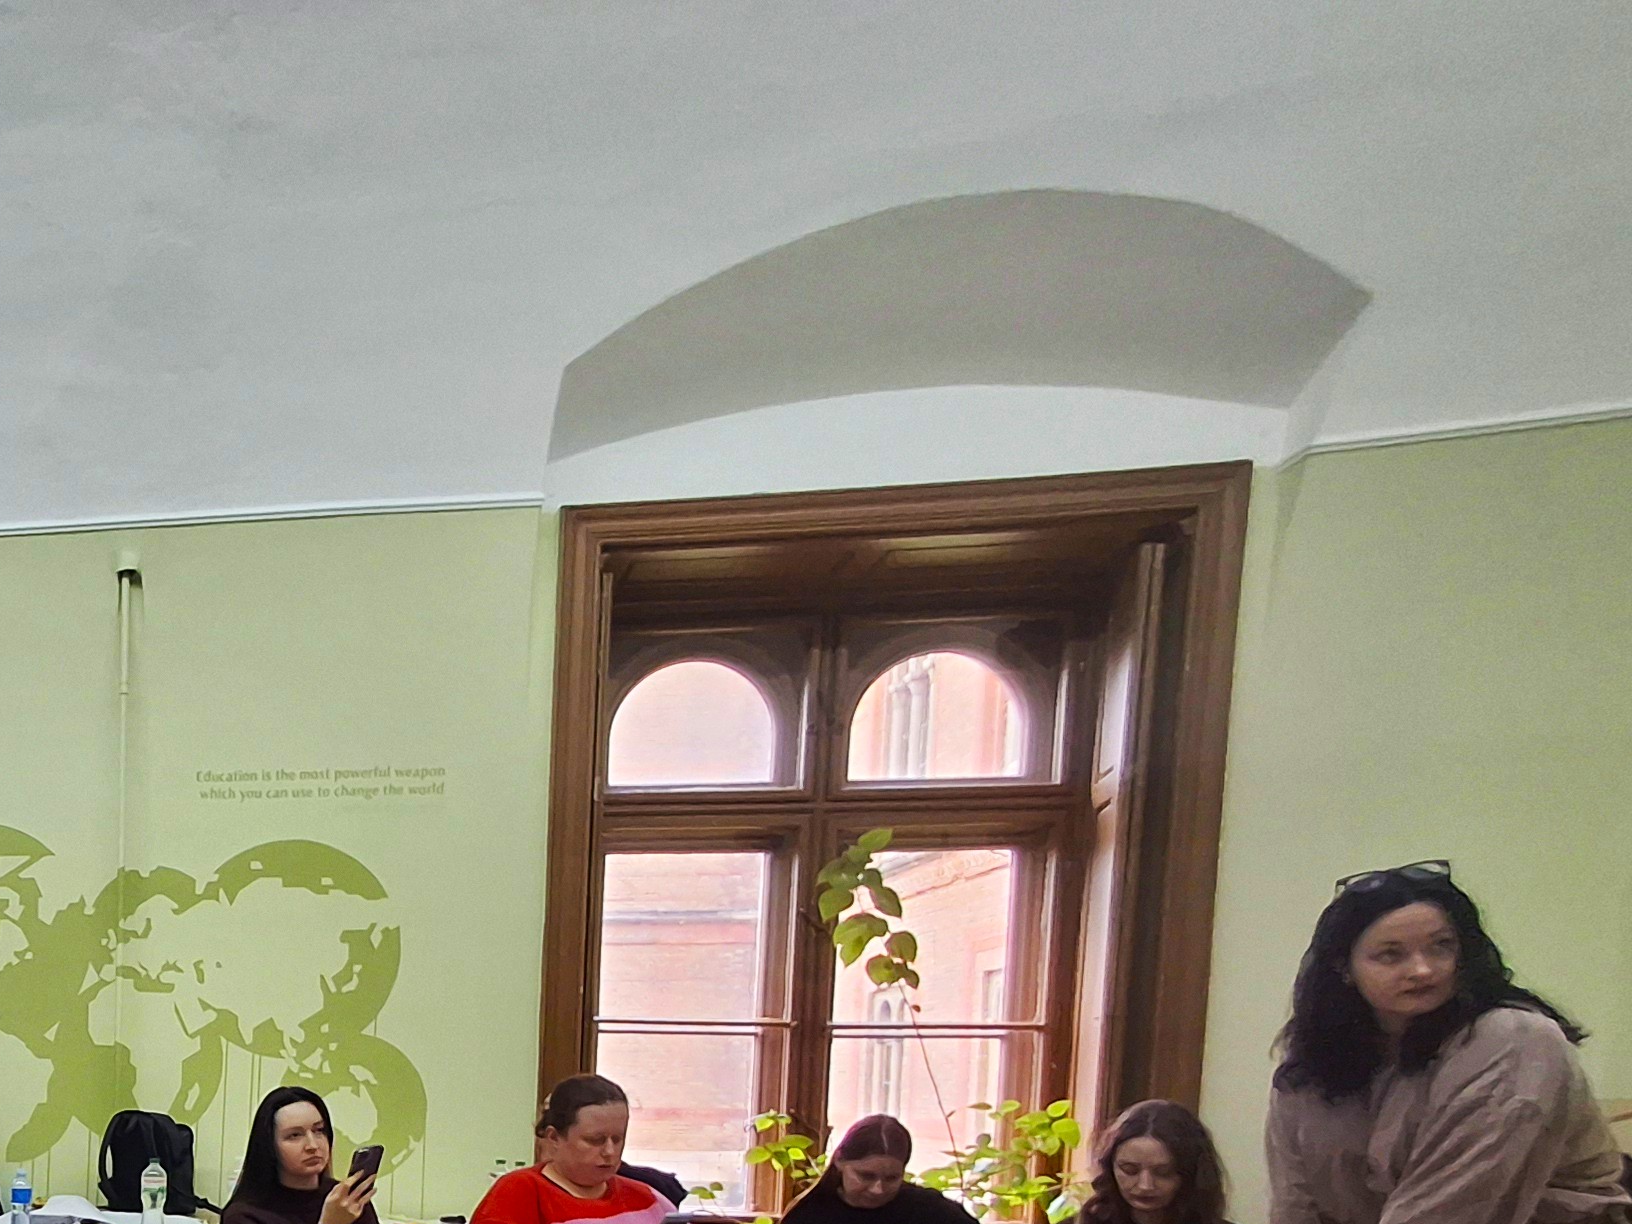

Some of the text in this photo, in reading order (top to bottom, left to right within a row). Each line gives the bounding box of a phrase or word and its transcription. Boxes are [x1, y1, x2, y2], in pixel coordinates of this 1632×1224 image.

[195, 766, 446, 784] Education is the most powerful weapon
[199, 783, 446, 803] which you can use to change the world
